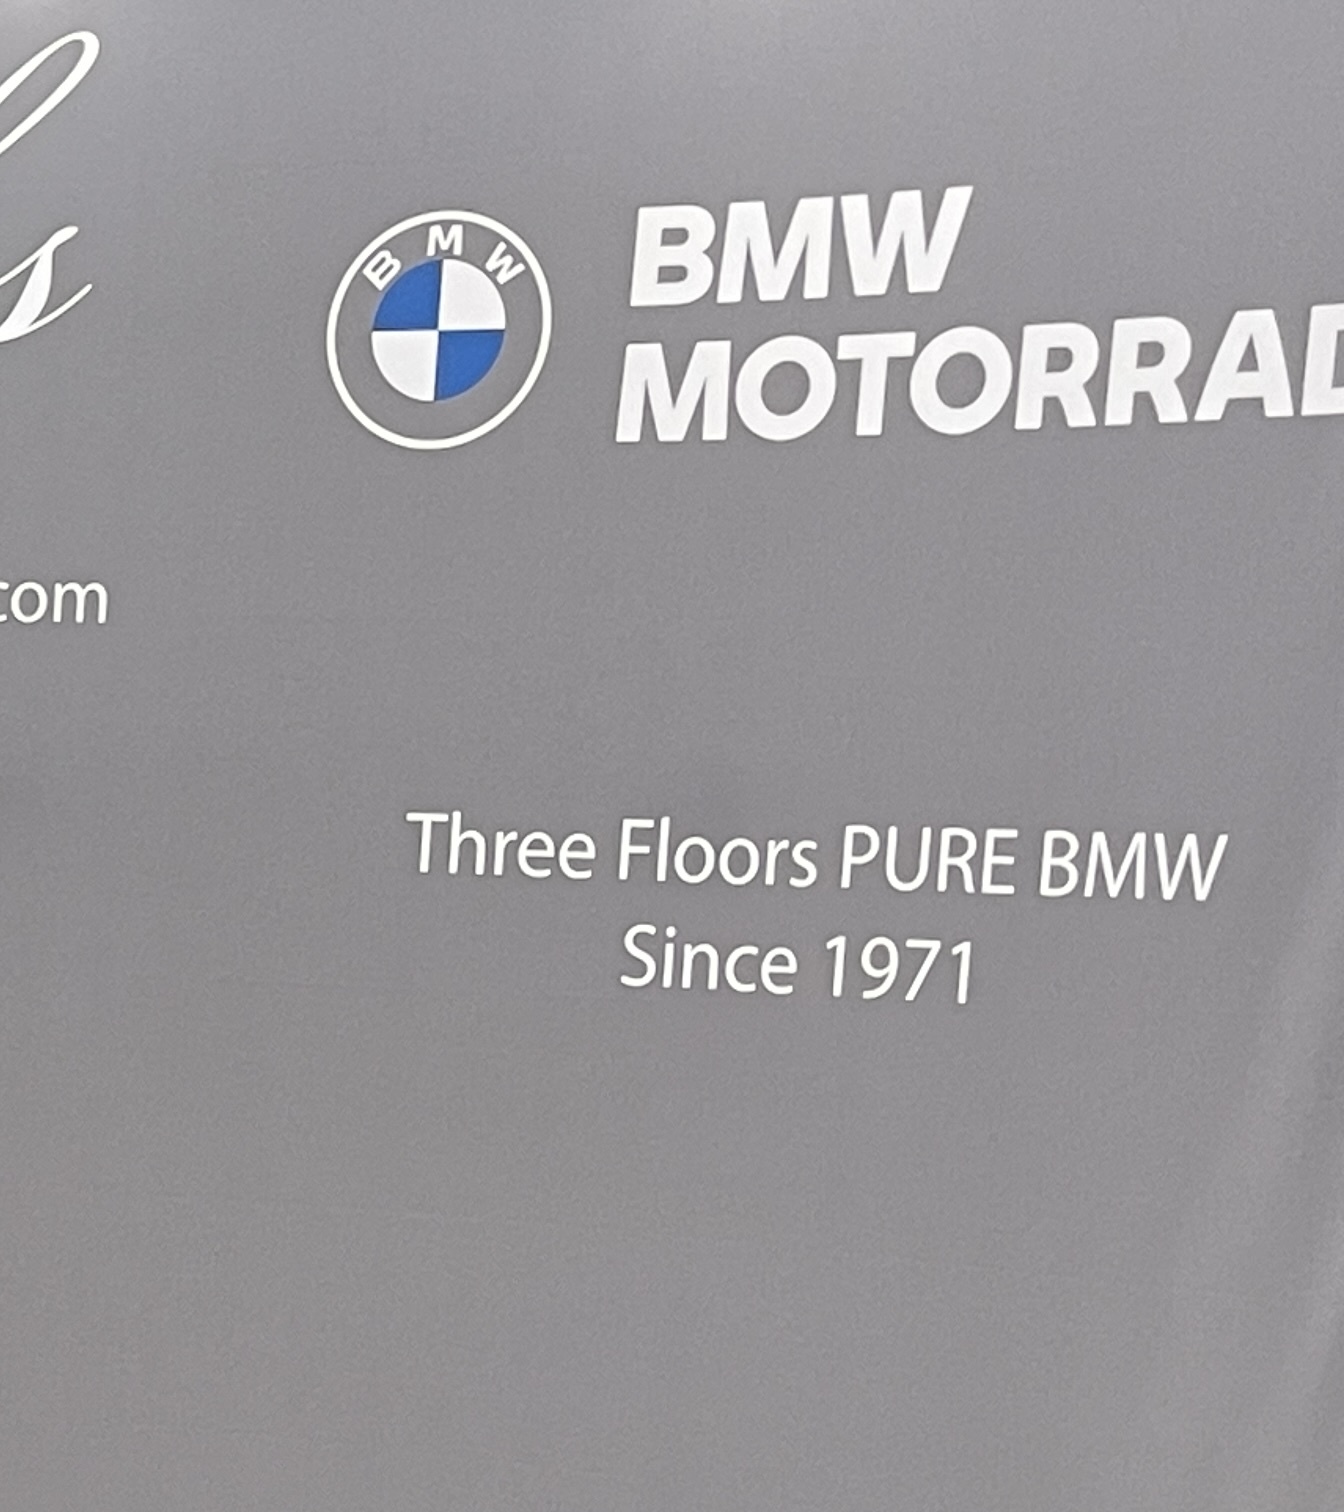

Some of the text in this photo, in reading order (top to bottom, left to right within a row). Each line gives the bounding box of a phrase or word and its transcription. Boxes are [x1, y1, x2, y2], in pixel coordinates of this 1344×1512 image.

[362, 223, 525, 290] BMW
[629, 185, 974, 307] BMW
[405, 810, 1230, 902] Three Floors PURE BMW
[619, 924, 972, 1004] Since 1971
